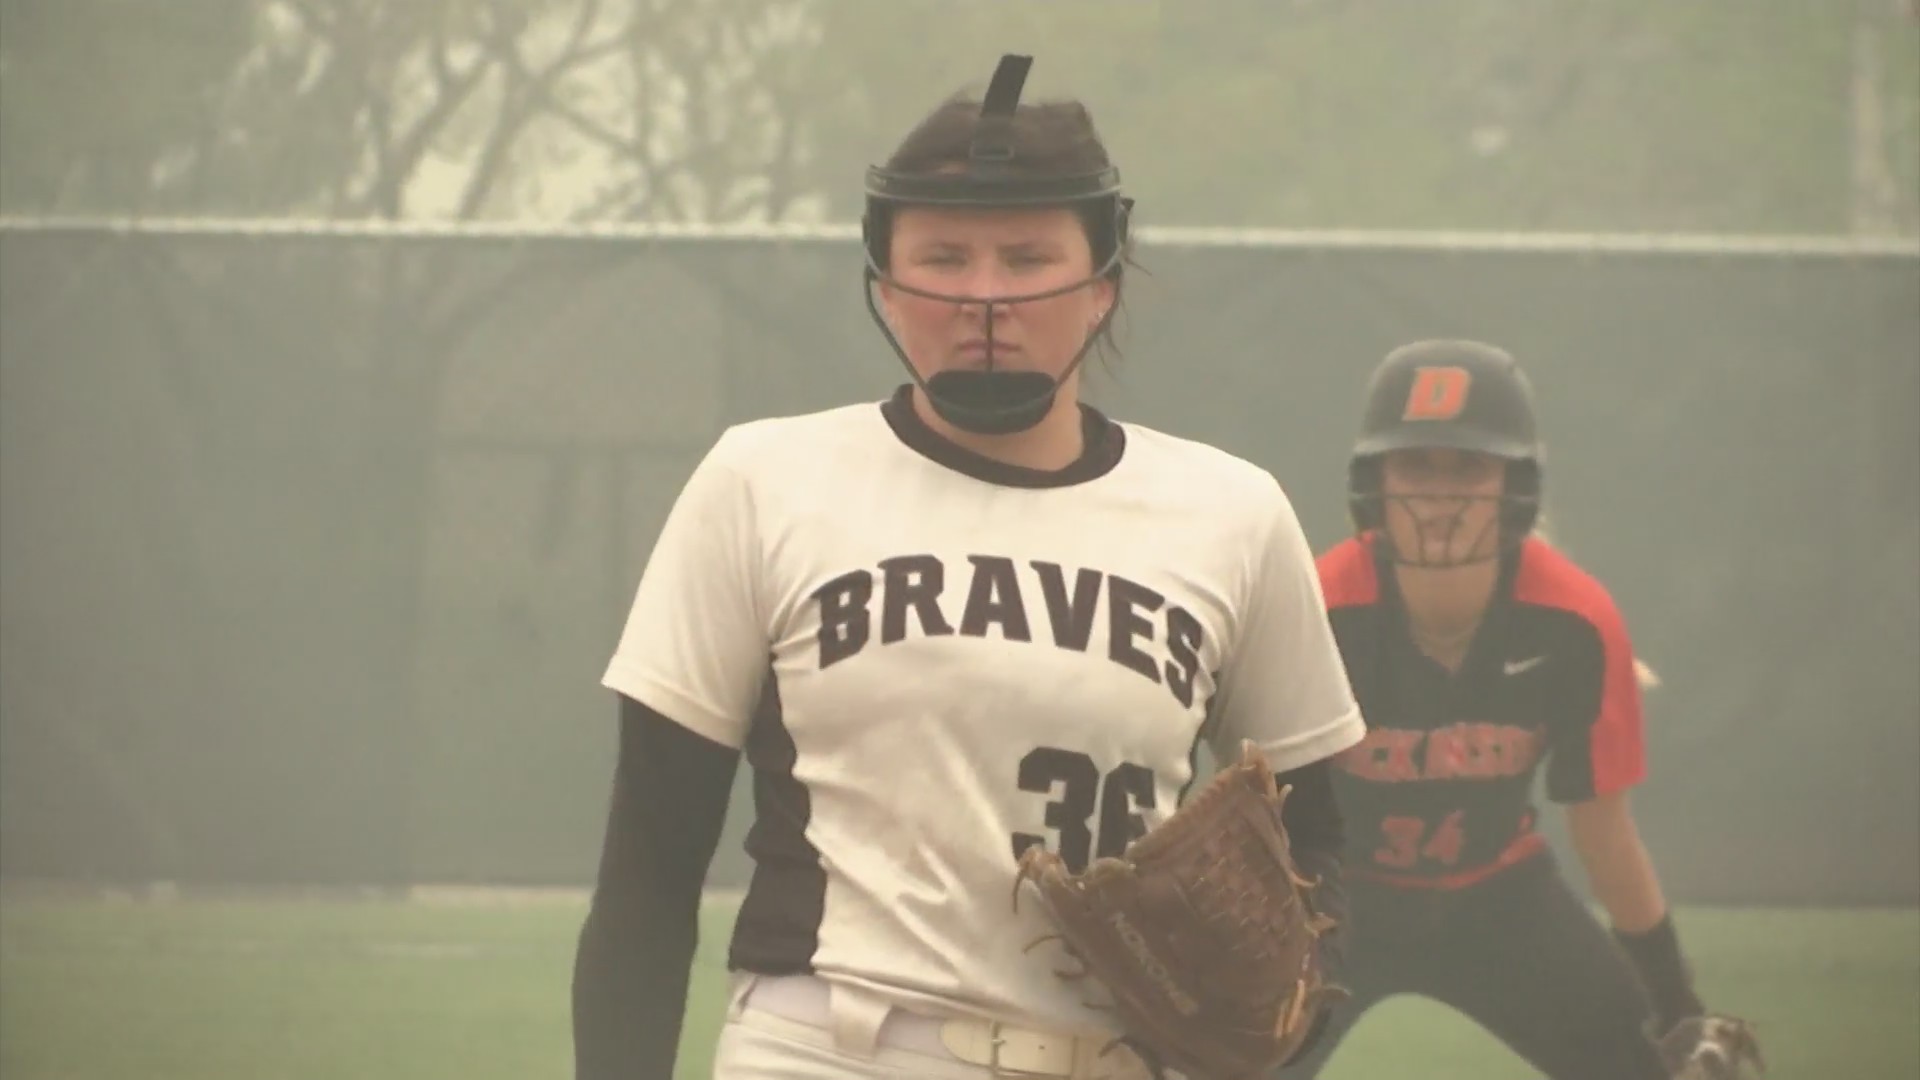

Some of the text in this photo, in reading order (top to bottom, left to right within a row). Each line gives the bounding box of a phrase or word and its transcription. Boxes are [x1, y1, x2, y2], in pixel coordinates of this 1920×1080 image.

[1402, 365, 1472, 421] D
[809, 553, 1203, 710] BRAVES
[1011, 746, 1156, 876] 36
[1372, 808, 1465, 868] 34
